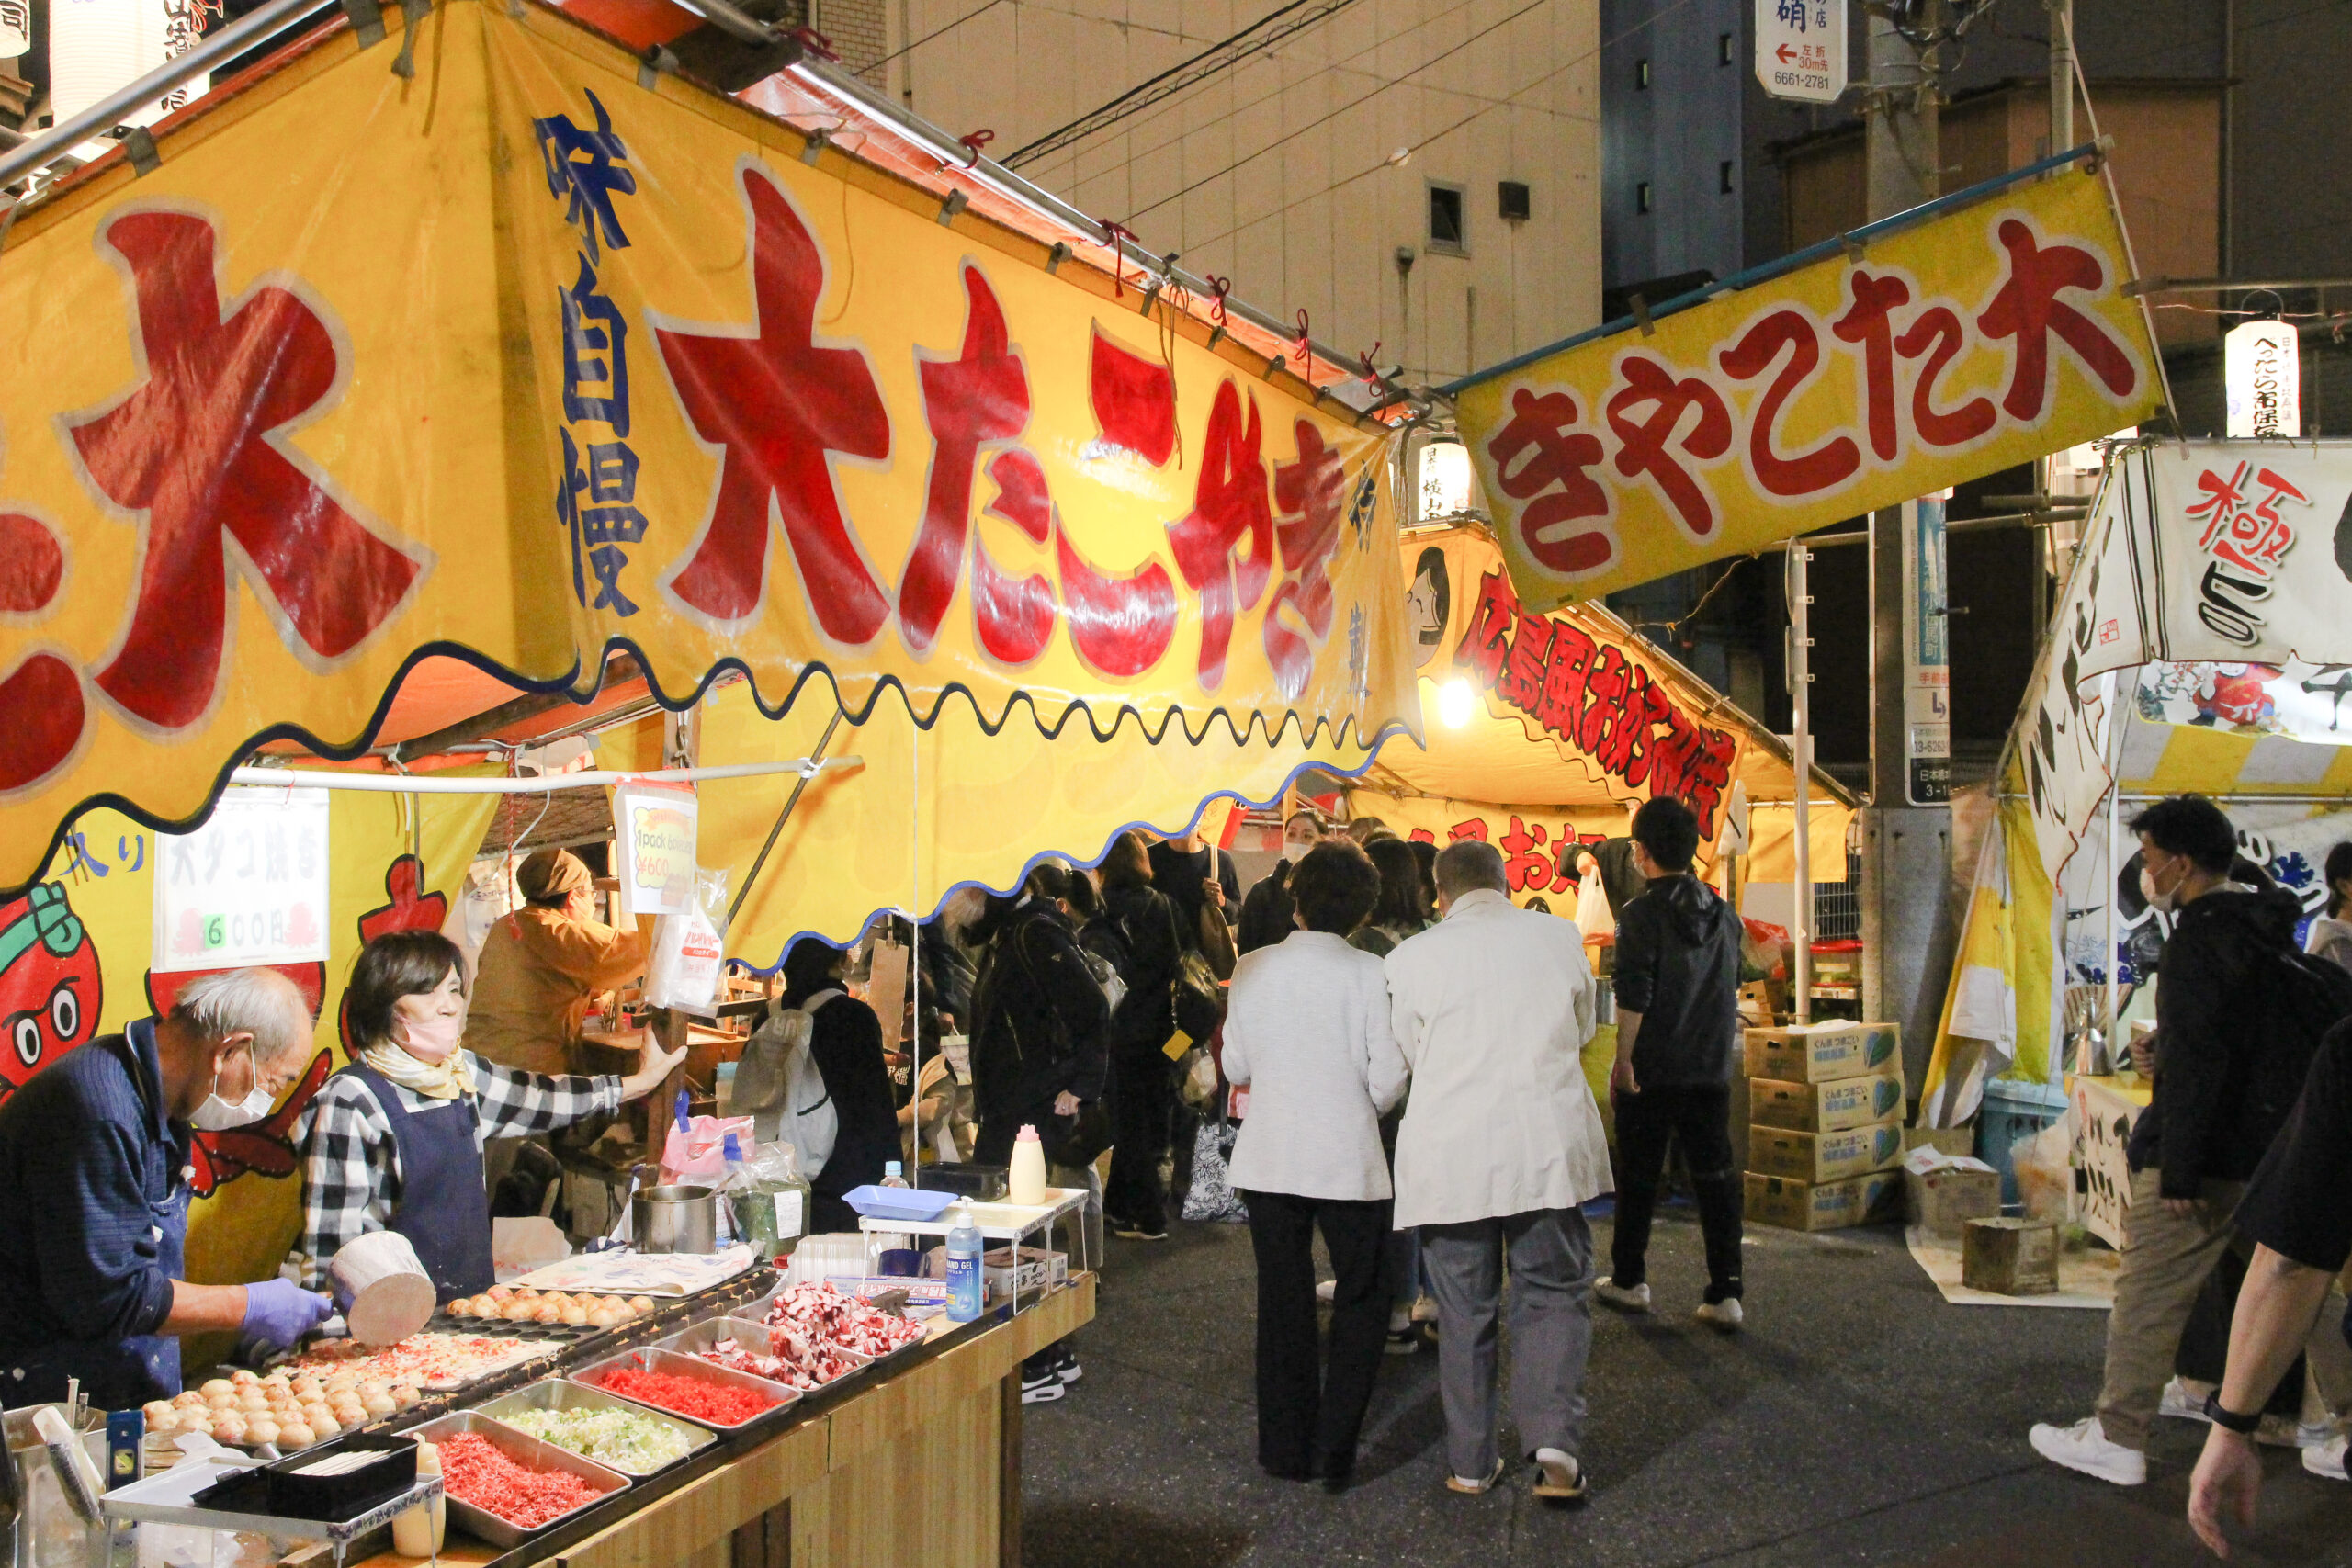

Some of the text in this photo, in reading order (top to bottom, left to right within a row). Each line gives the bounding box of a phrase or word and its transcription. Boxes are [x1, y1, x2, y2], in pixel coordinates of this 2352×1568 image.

[1803, 44, 1826, 58] 左折
[1798, 57, 1828, 72] 30m先
[1774, 72, 1829, 89] 6661-2781
[653, 171, 1346, 701] 大たこやき
[638, 854, 670, 877] ¥600
[960, 1261, 973, 1270] GEL
